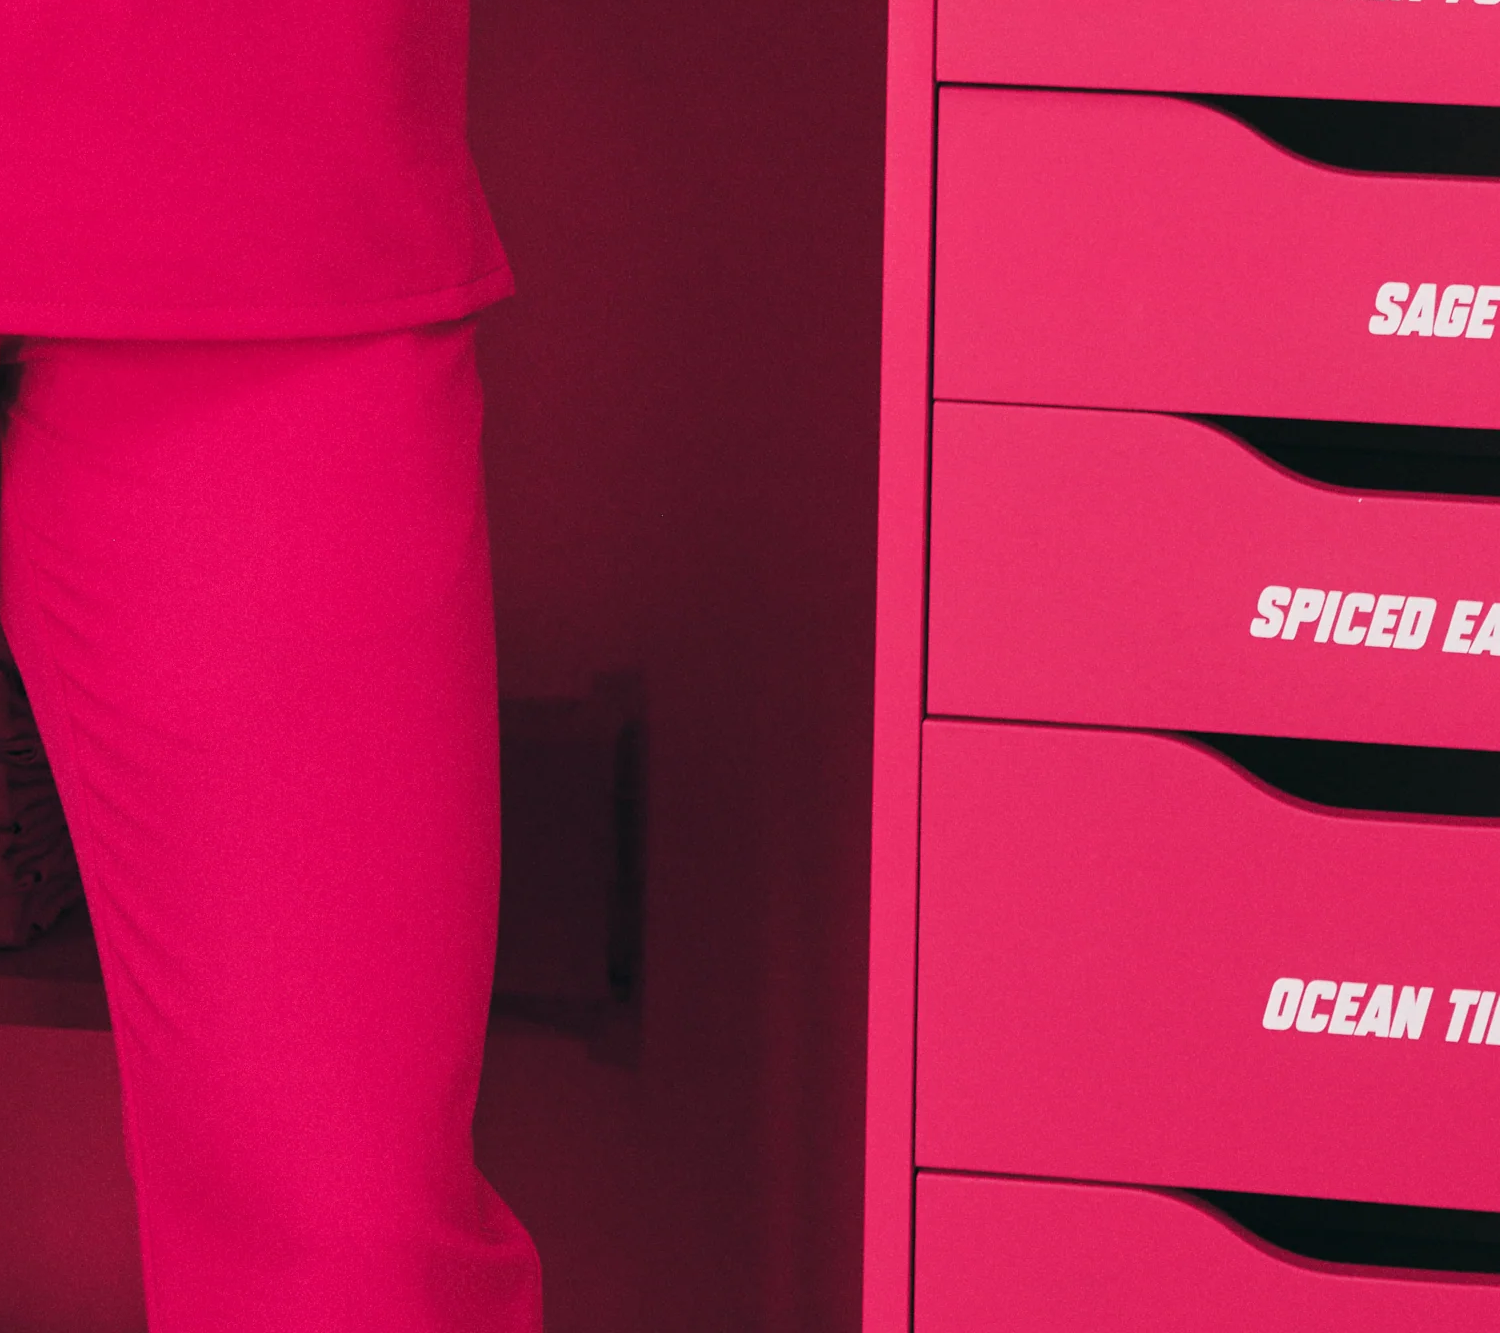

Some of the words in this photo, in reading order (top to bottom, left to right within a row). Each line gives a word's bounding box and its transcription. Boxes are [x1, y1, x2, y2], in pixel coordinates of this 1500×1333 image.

[1369, 282, 1500, 340] SAGE
[1250, 586, 1438, 651] SPICED
[1263, 978, 1435, 1041] OCEAN
